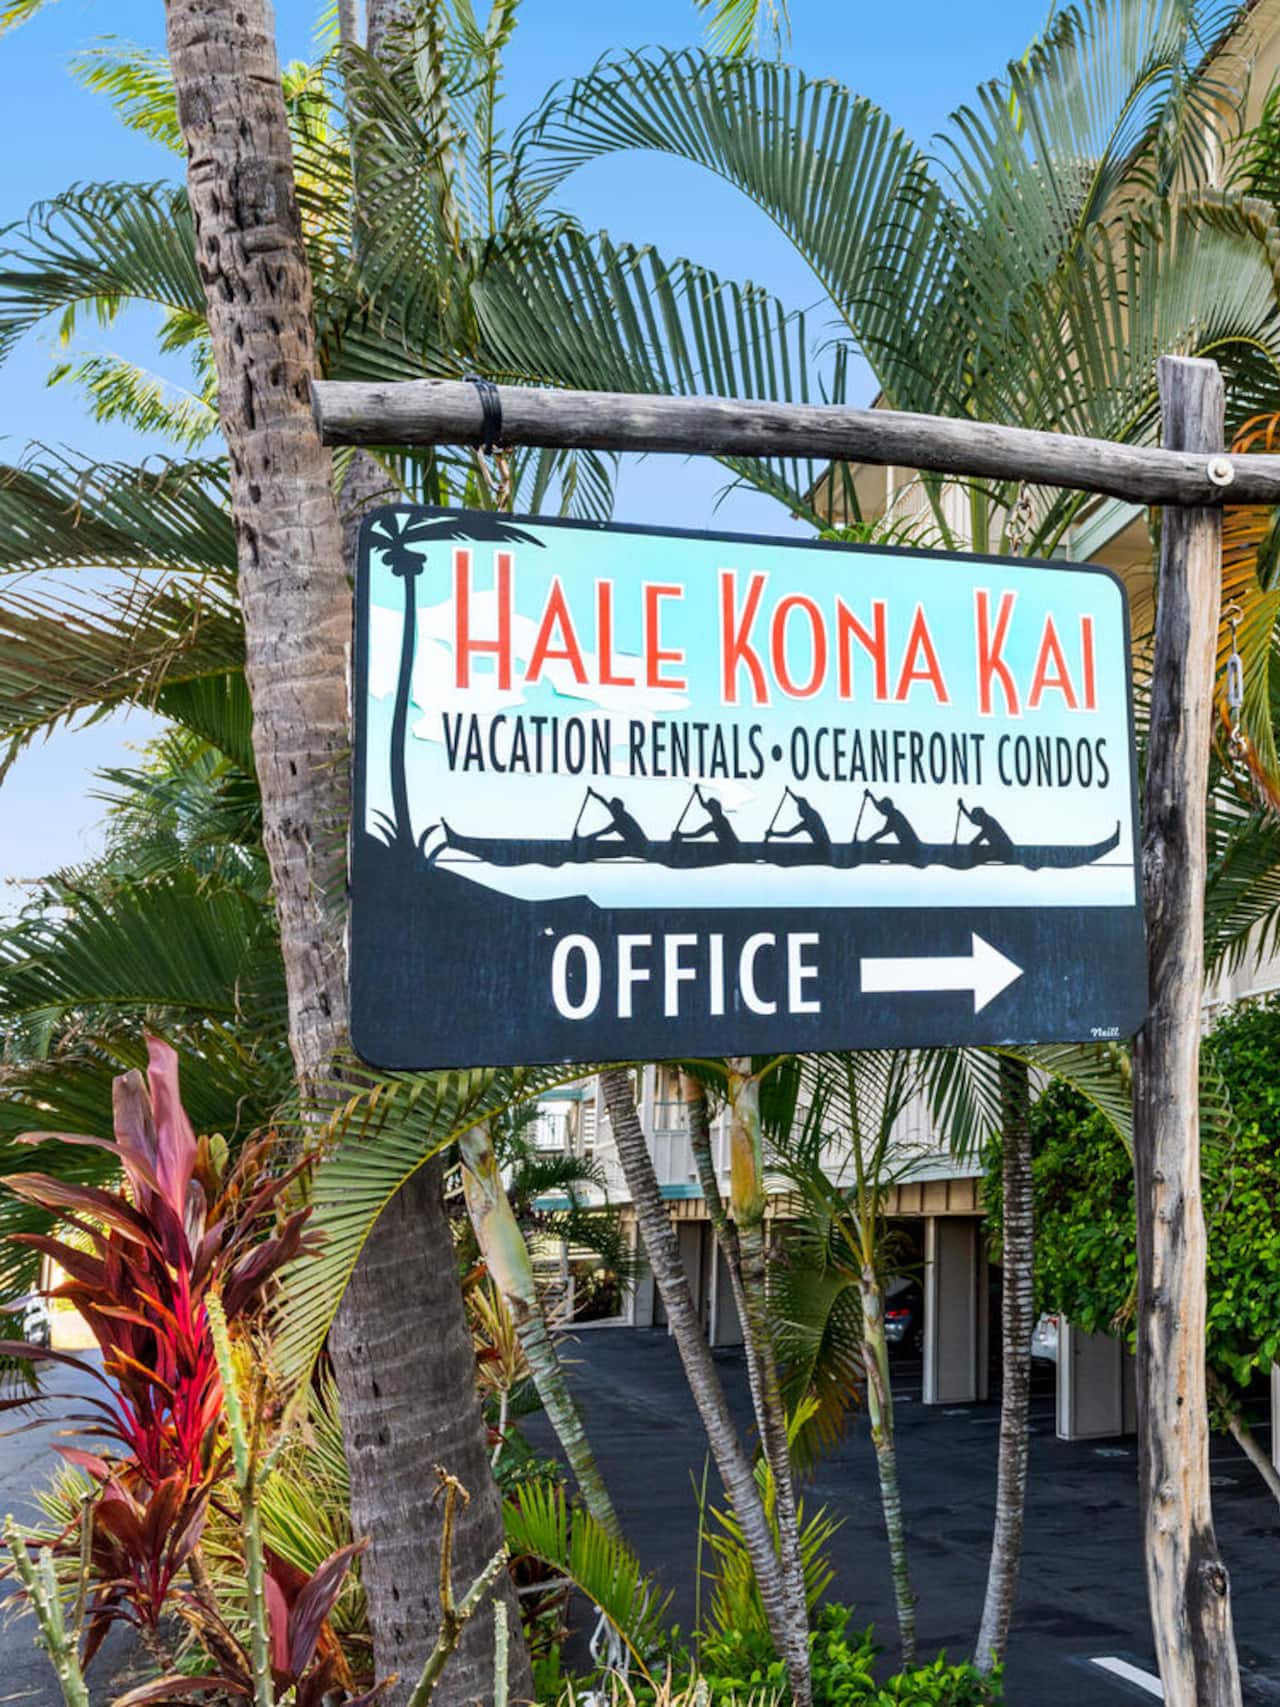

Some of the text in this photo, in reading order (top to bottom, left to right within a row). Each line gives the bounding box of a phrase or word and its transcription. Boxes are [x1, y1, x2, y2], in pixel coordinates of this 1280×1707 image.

[454, 549, 1096, 715] HALE KONA KAI
[441, 711, 612, 775] VACATION
[997, 734, 1111, 789] CONDOS
[550, 931, 822, 1022] OFFICE
